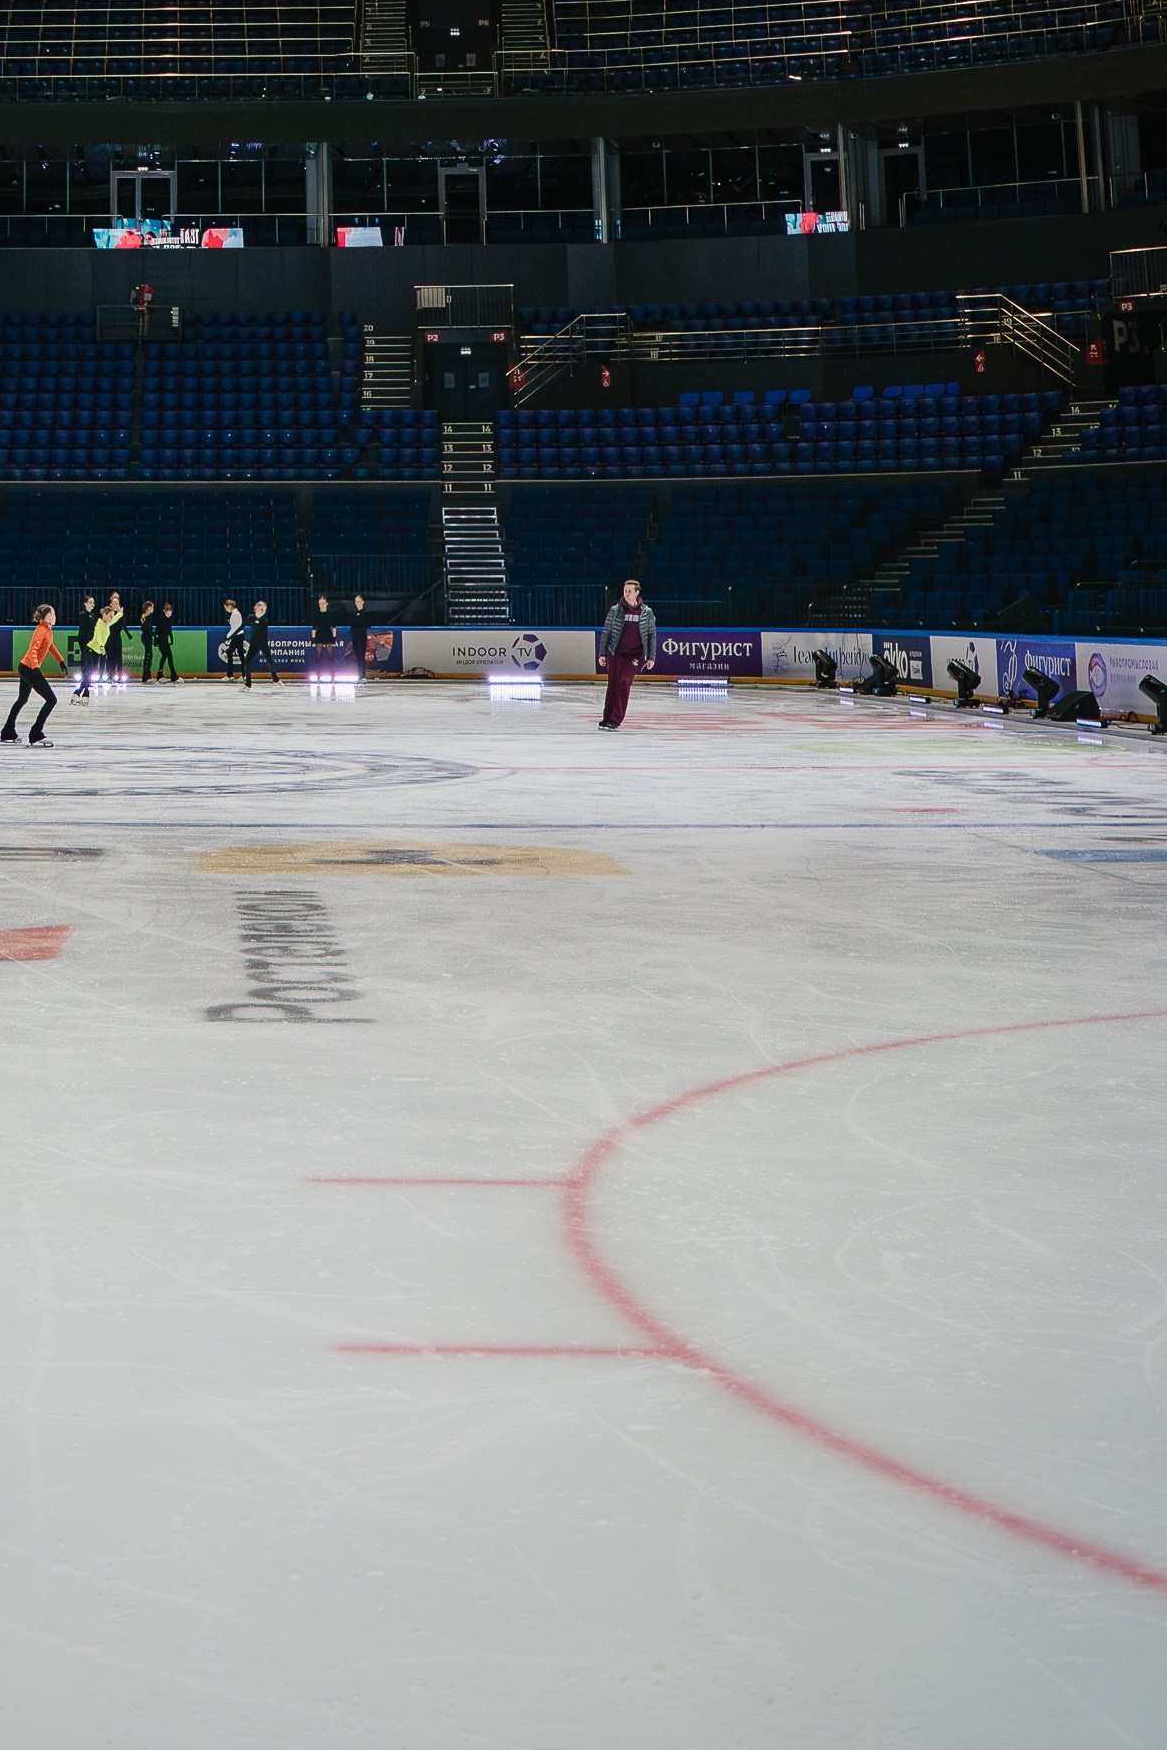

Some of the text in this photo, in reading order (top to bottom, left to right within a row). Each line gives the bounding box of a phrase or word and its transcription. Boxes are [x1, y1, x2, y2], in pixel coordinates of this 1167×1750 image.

[1121, 303, 1132, 311] P3
[363, 324, 374, 332] 20
[427, 333, 439, 342] P2
[493, 333, 505, 341] P3
[364, 372, 373, 380] 17
[363, 390, 372, 398] 16
[443, 425, 453, 433] 14
[481, 425, 491, 433] 14
[1051, 428, 1061, 437] 13
[443, 444, 453, 453] 13
[482, 444, 492, 453] 13
[1033, 448, 1042, 458] 12
[443, 464, 453, 472] 12
[483, 464, 492, 472] 12
[1013, 471, 1022, 480] 11
[444, 484, 452, 492] 11
[484, 484, 492, 492] 11
[452, 647, 533, 657] INDOOR TV
[662, 638, 753, 661] Фигурист
[689, 662, 729, 670] магазин
[203, 890, 378, 1023] Ростелеком
